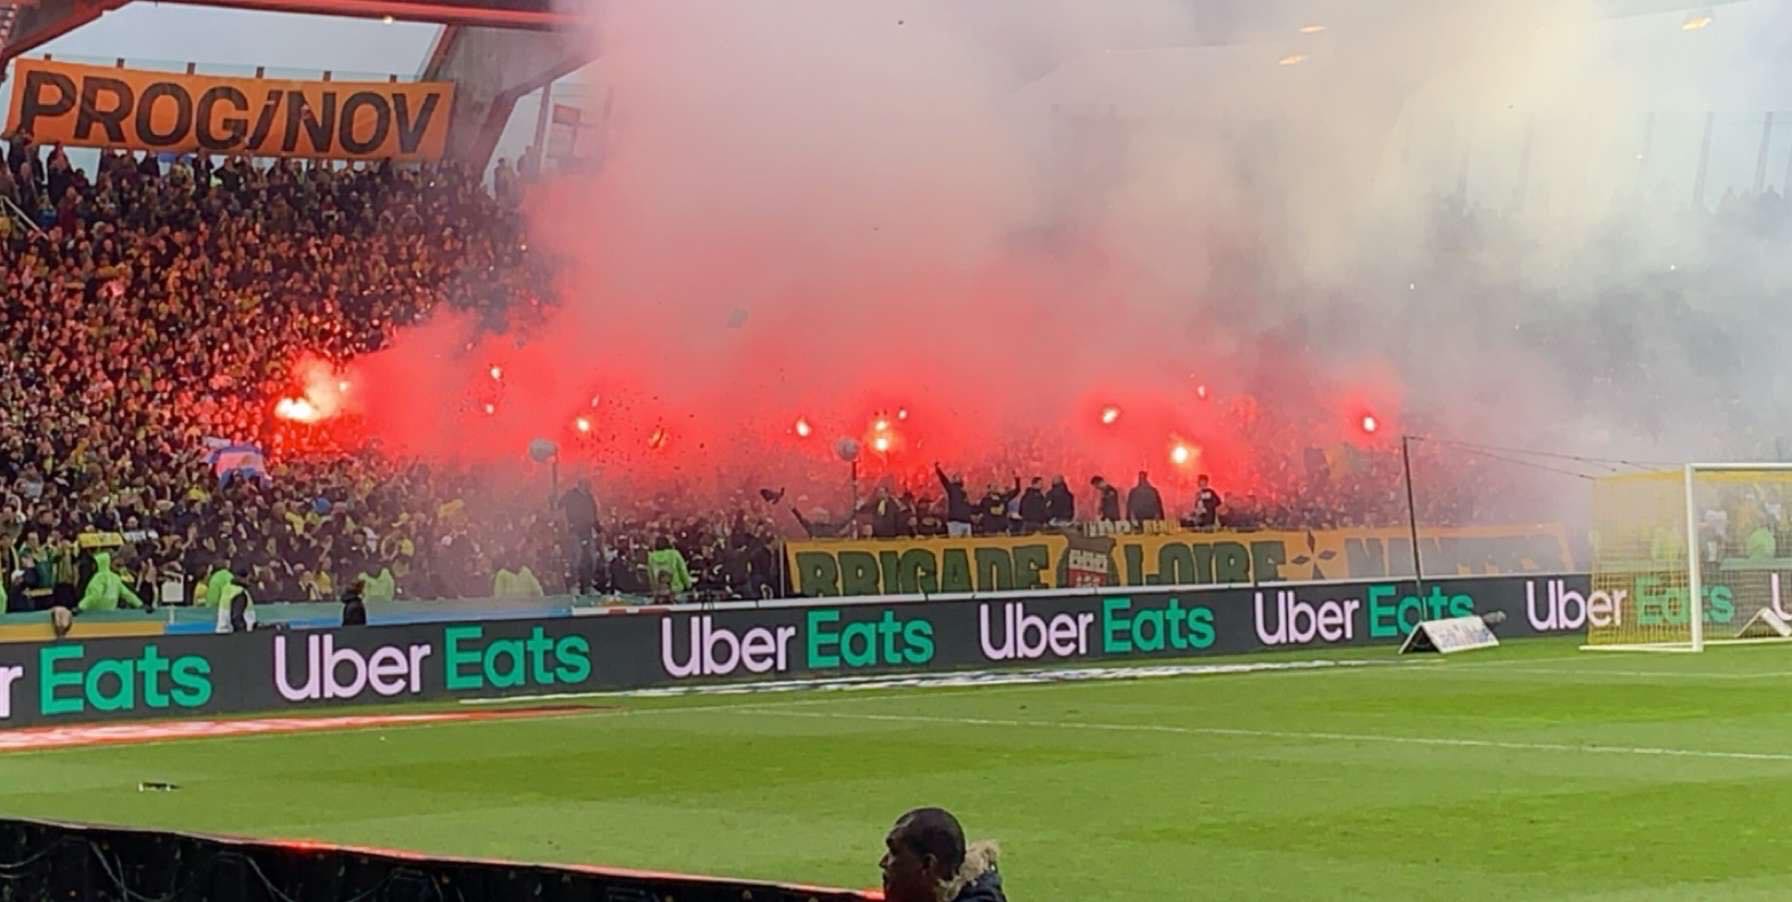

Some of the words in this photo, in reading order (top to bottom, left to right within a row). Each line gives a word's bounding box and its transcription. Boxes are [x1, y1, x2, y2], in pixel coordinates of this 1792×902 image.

[795, 543, 1051, 597] BRIGADE
[978, 601, 1094, 660] Uber
[1102, 596, 1215, 655] Eats
[1254, 589, 1361, 645] Uber
[1367, 584, 1475, 637] Eats
[1525, 578, 1628, 632] Uber
[274, 632, 432, 701] Uber
[444, 624, 592, 691] Eats
[660, 614, 796, 678] Uber
[806, 609, 936, 670] Eats
[40, 643, 213, 716] Eats
